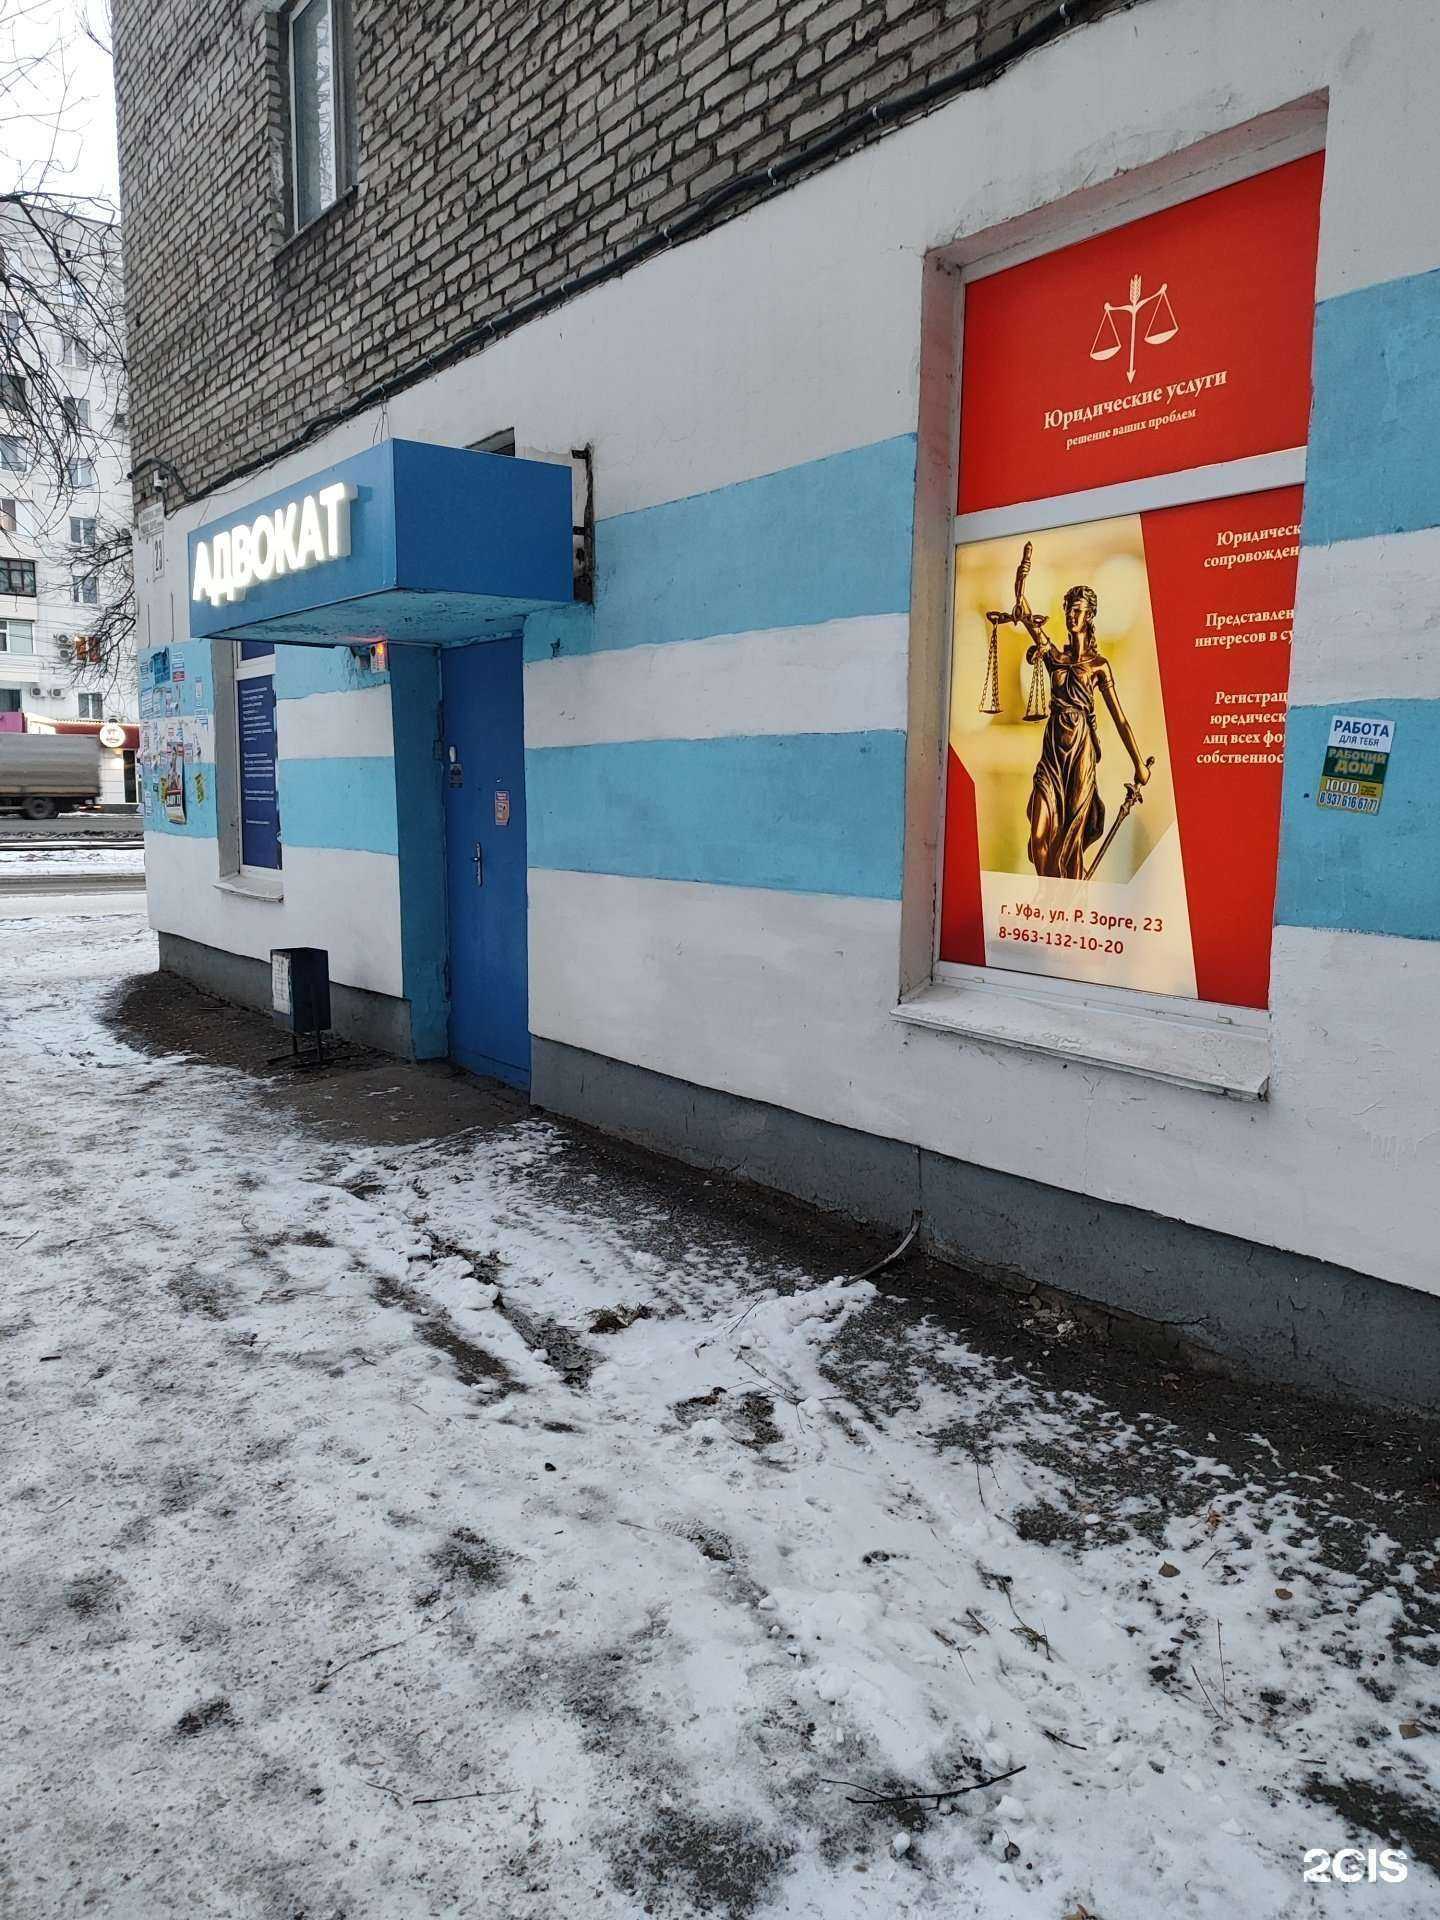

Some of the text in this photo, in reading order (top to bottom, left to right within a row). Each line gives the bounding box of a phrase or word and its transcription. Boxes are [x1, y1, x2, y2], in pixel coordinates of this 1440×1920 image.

[1043, 370, 1228, 430] Юридические услуги
[1066, 408, 1197, 450] решение ваших проблем
[192, 481, 352, 607] АДВОКАТ
[1216, 524, 1301, 548] Юридическ
[1203, 546, 1300, 569] сопровожден
[1205, 609, 1295, 630] Представлен
[1194, 632, 1267, 649] интересов
[1269, 631, 1278, 642] в
[1334, 719, 1389, 738] РАБОТА
[1203, 734, 1229, 746] лиц
[1230, 733, 1261, 744] всех
[1339, 734, 1380, 747] ДЛЯ ТЕБЯ
[1196, 749, 1284, 764] собственнос
[1328, 747, 1387, 764] РАБОЧИЙ
[1334, 759, 1375, 775] ДОМ
[1326, 778, 1360, 795] 1000
[1000, 903, 1163, 933] г. Уфа, ул. Р. Зорге, 23
[998, 926, 1124, 954] 8-963-132-10-20
